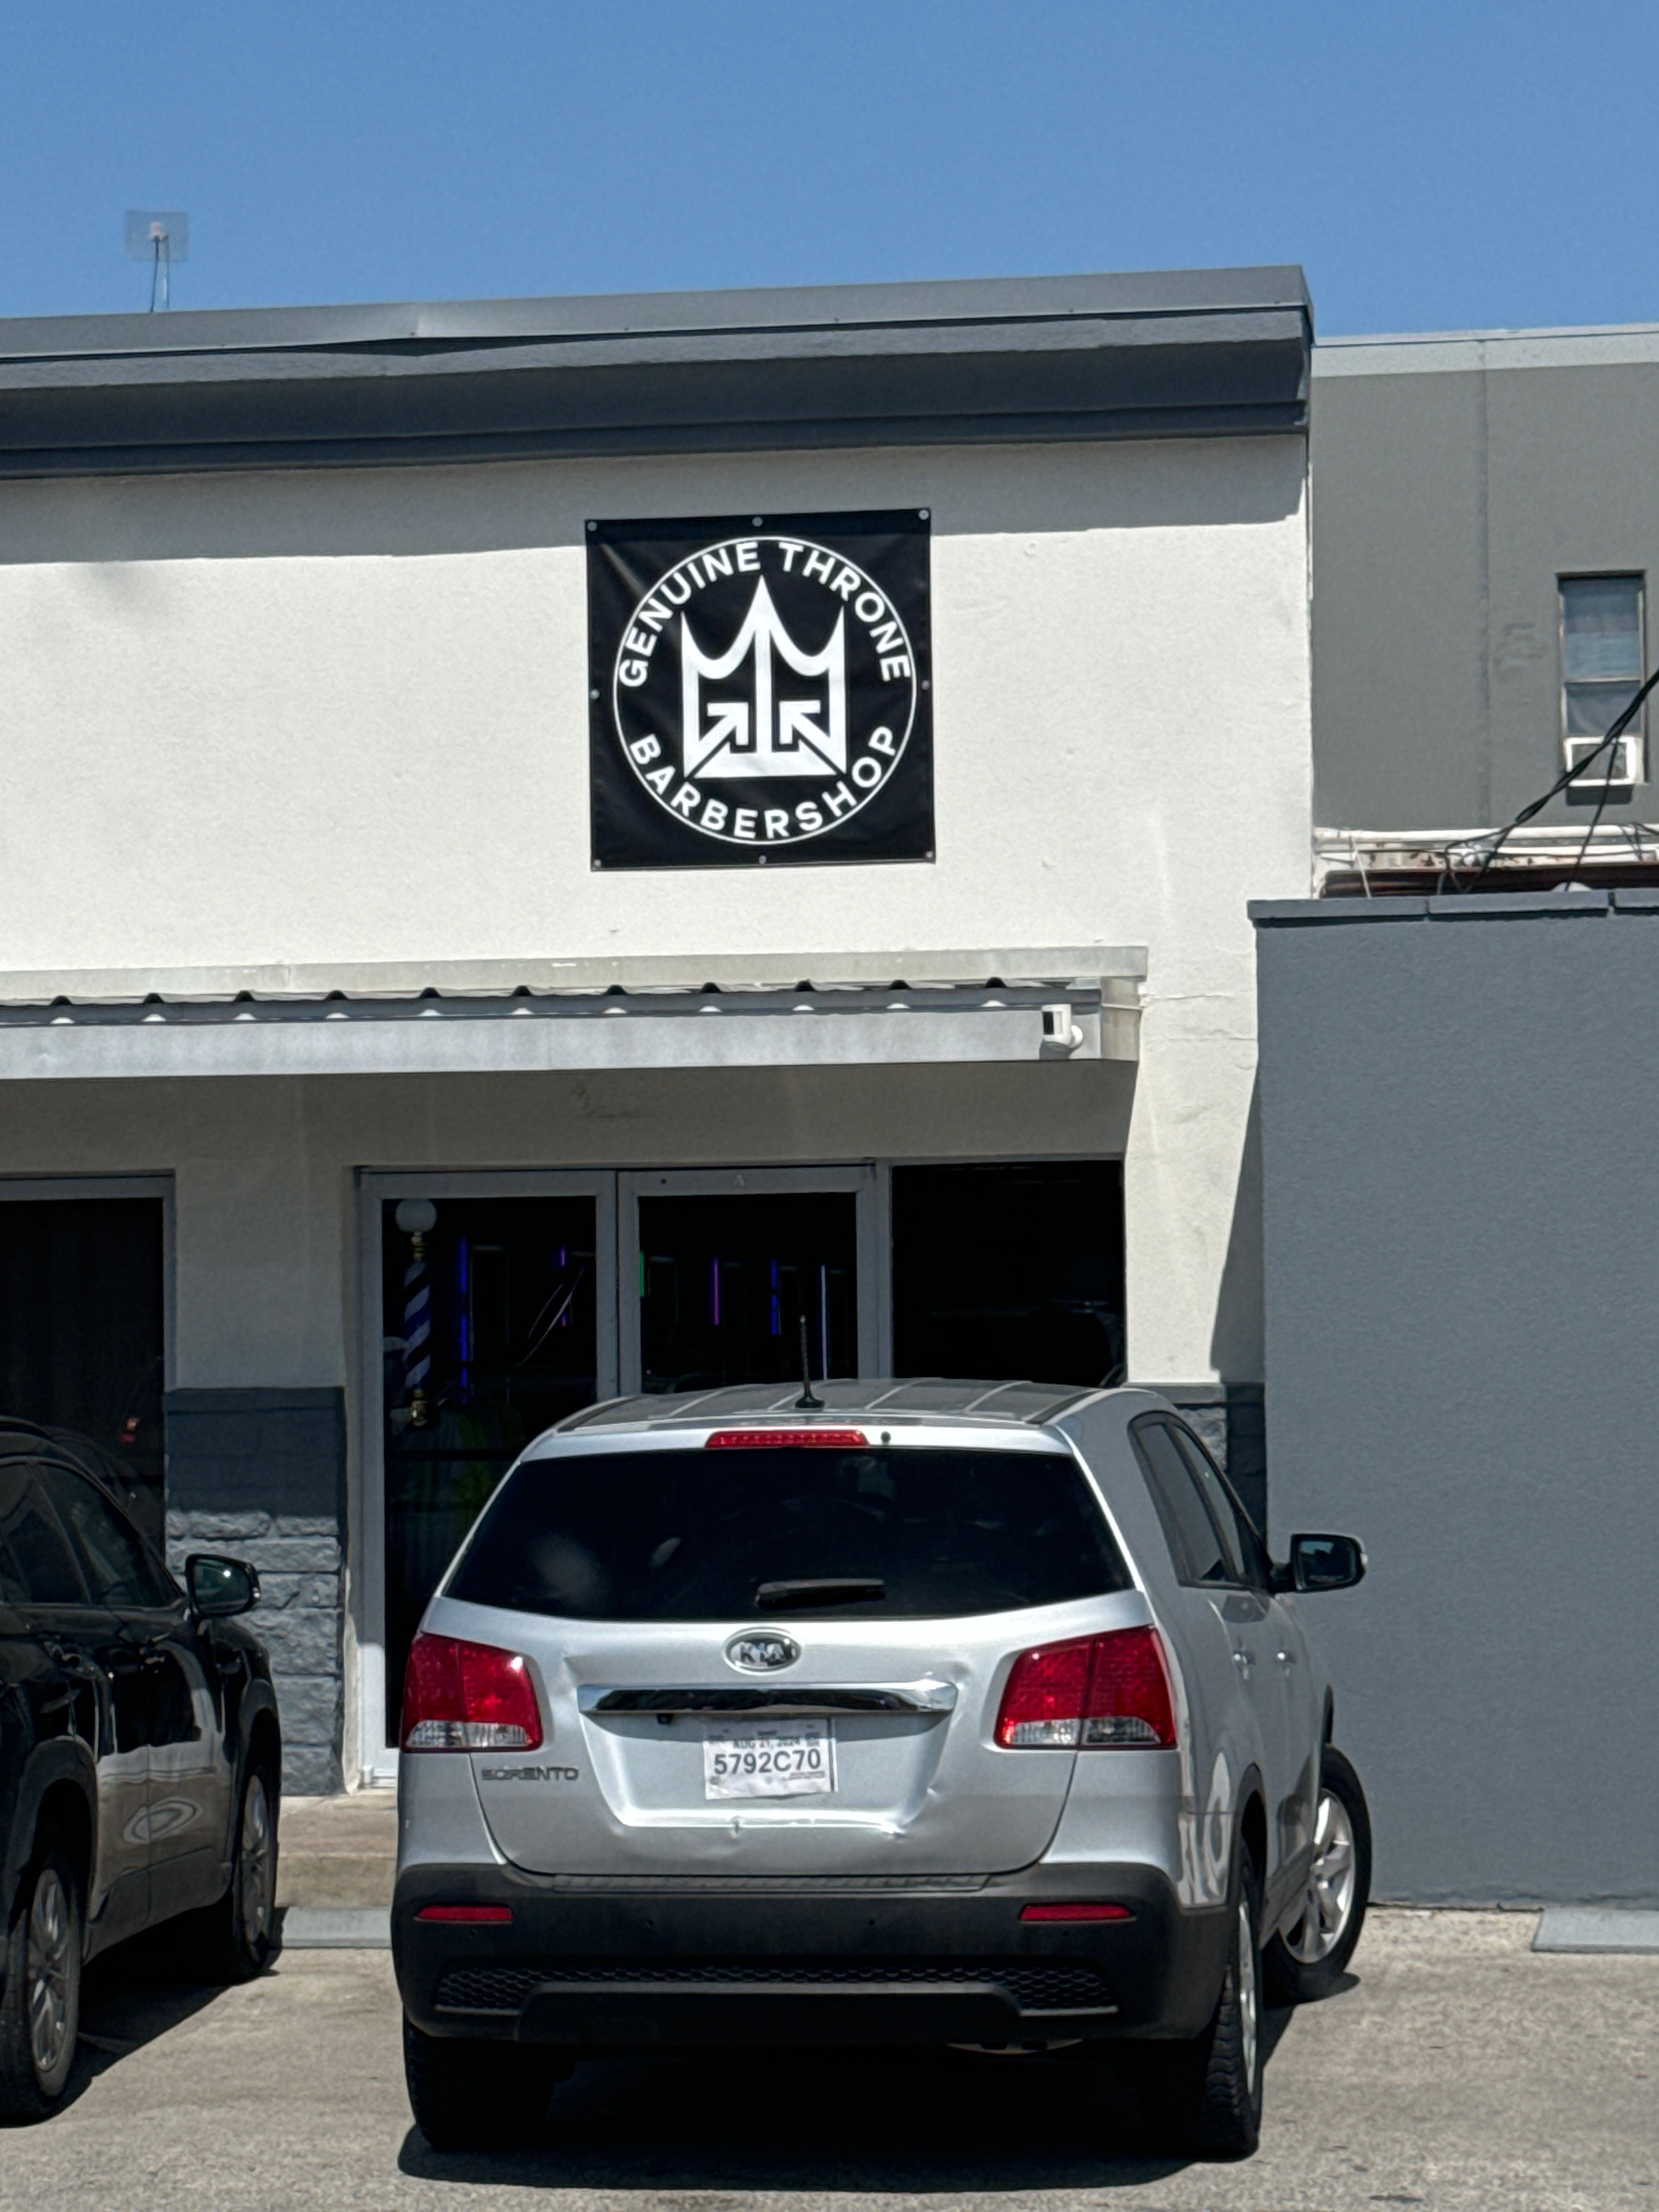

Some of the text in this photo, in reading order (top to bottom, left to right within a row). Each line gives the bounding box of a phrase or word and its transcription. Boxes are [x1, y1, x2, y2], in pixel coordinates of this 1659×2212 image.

[619, 541, 911, 687] GENUINE THRONE
[630, 726, 896, 838] BARBERSHOP
[740, 1642, 787, 1666] KIA
[481, 1766, 579, 1781] SORENTO
[714, 1748, 821, 1775] 5792C70
